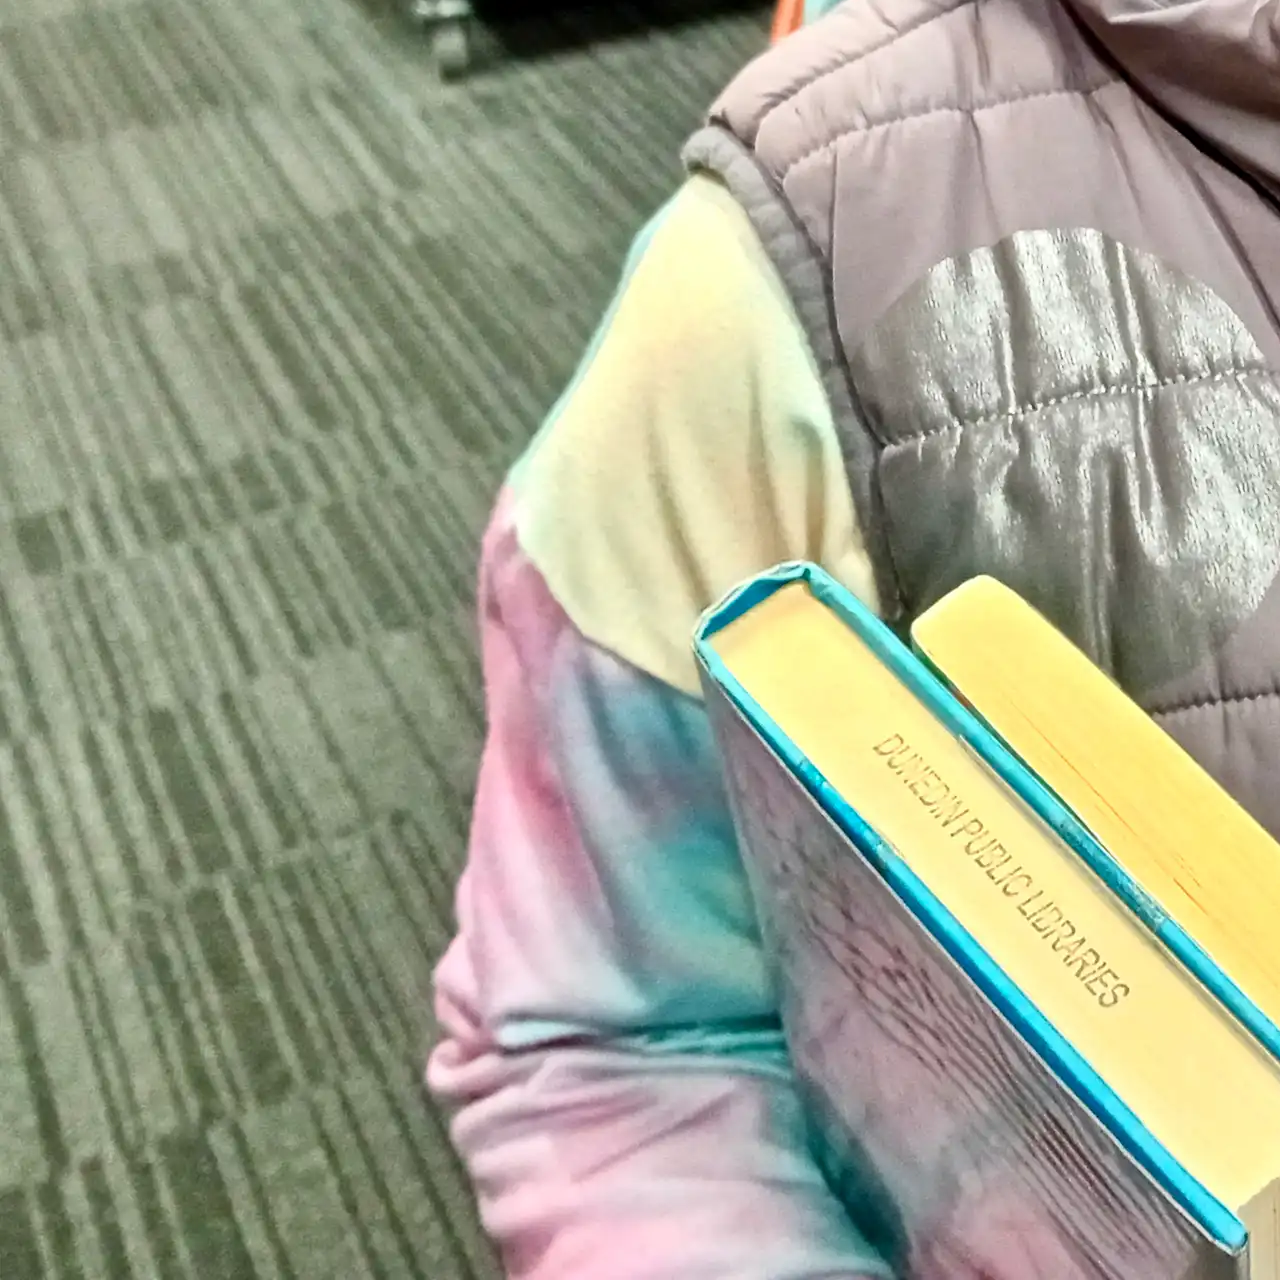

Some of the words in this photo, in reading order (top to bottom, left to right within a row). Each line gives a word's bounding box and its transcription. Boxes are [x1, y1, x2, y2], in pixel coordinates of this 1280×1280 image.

[872, 733, 970, 829] DUNEDIN
[949, 817, 1034, 898] PUBLIC
[1015, 889, 1131, 1009] LIBRARIES
